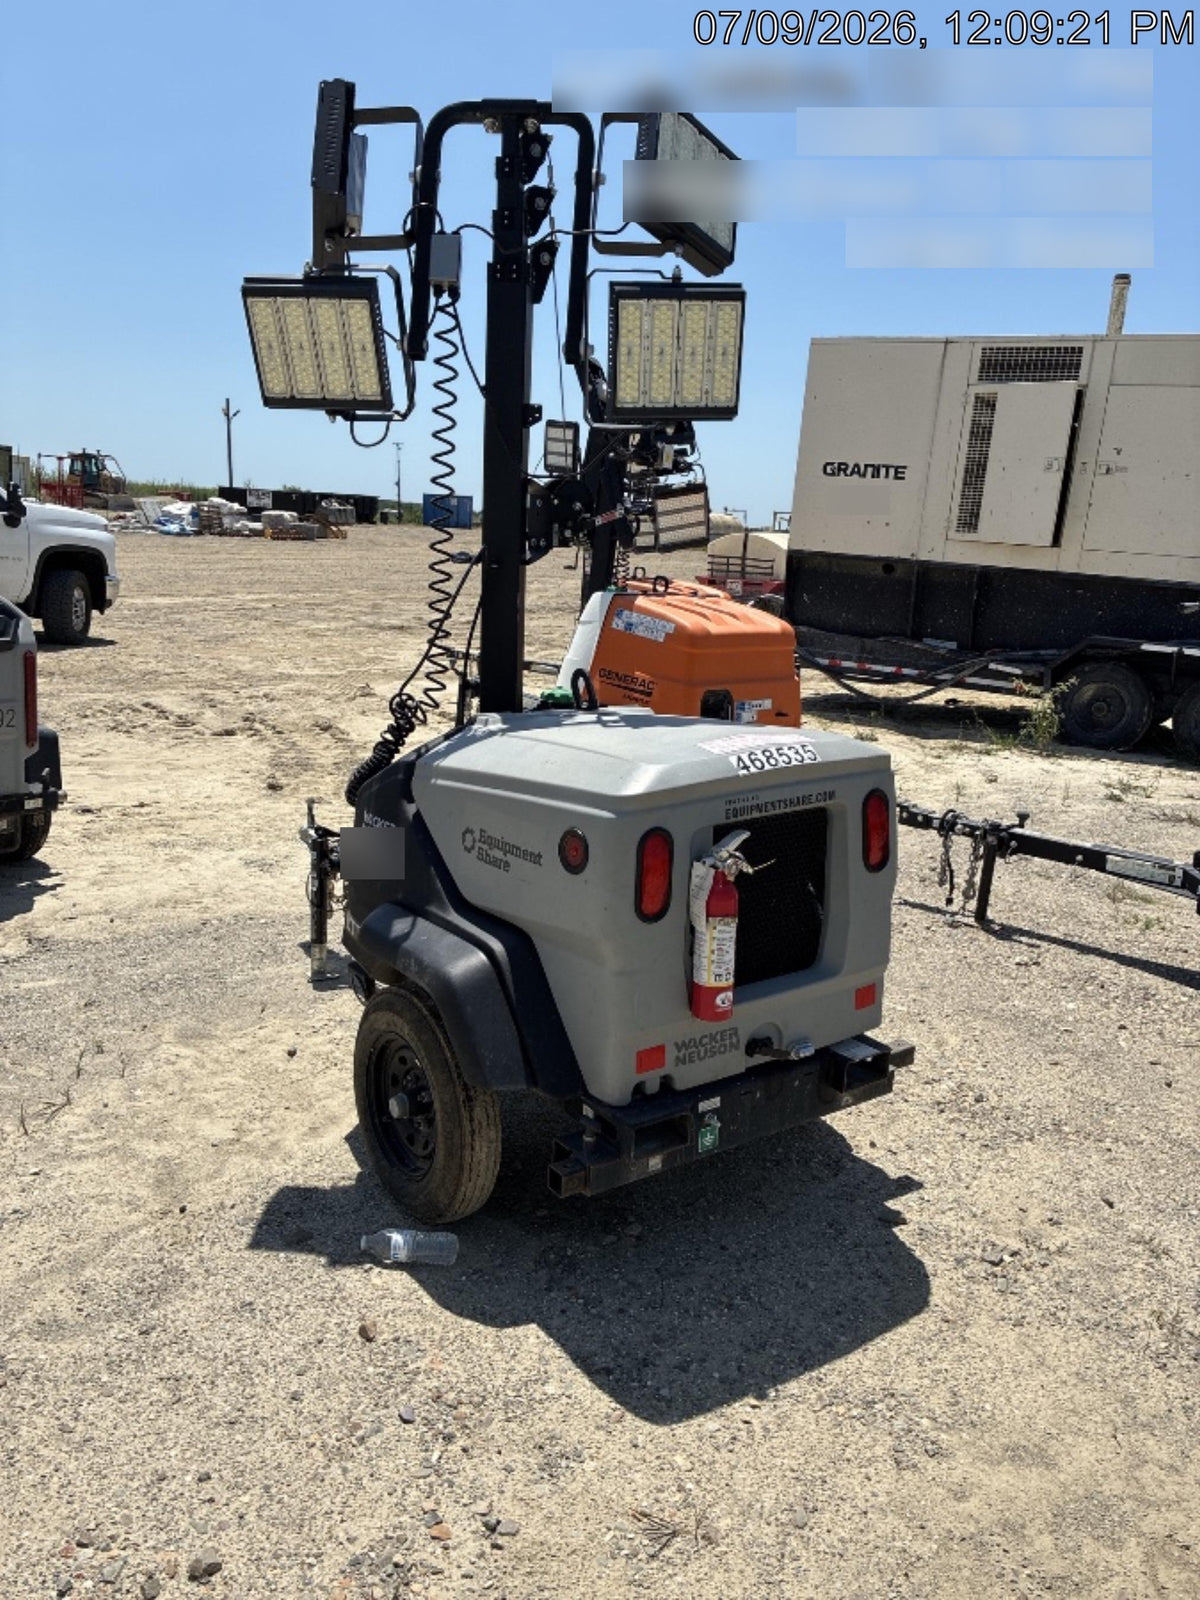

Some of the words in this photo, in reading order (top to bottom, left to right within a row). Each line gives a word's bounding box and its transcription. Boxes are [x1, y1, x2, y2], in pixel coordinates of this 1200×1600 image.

[822, 461, 907, 481] GRANITE
[598, 667, 656, 691] GENERAC
[736, 744, 817, 772] 468535
[724, 789, 836, 820] EQUIPMENTSHARE.COM
[476, 846, 511, 873] Share
[478, 827, 543, 867] Equipment
[673, 1026, 740, 1053] WACKER
[674, 1040, 740, 1067] NEUSON
